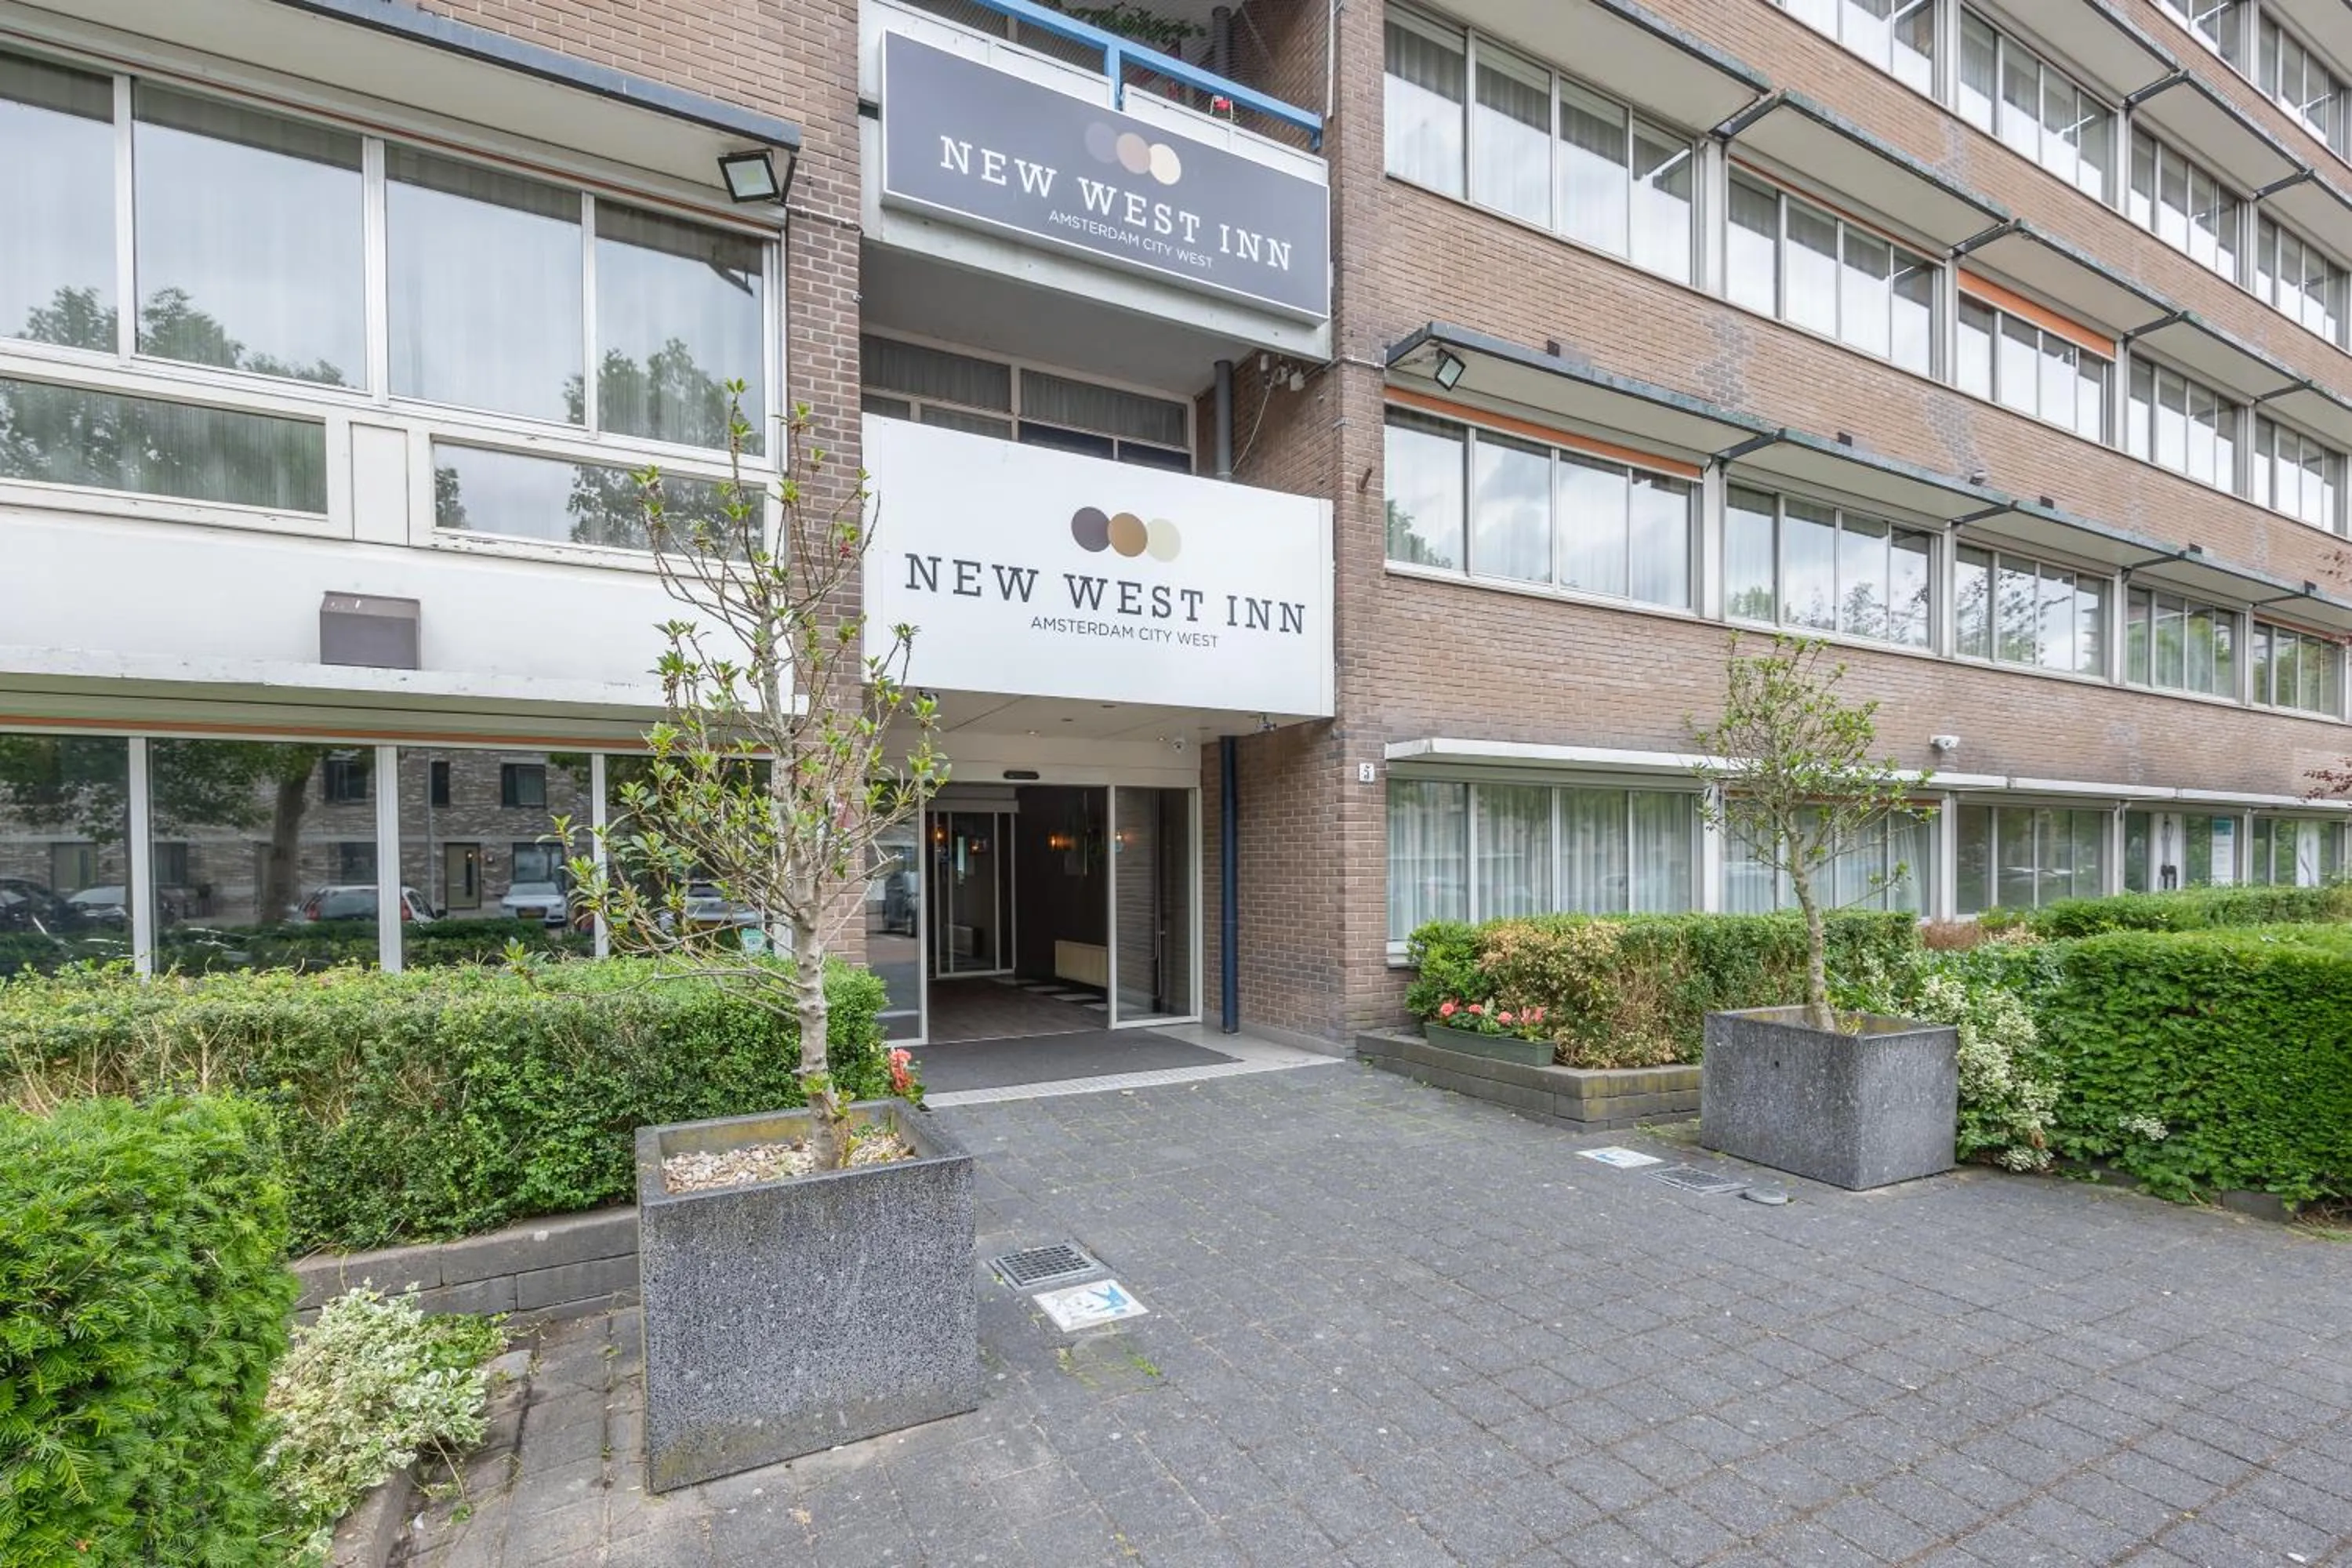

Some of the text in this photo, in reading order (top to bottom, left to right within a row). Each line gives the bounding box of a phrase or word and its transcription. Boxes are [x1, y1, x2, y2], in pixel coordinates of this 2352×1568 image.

[940, 135, 1292, 271] NEW WEST INN
[1048, 209, 1213, 268] AMSTERDAM CITY WEST
[904, 553, 1305, 634] NEW WEST INN
[1030, 616, 1218, 648] AMSTERDAM CITY WEST
